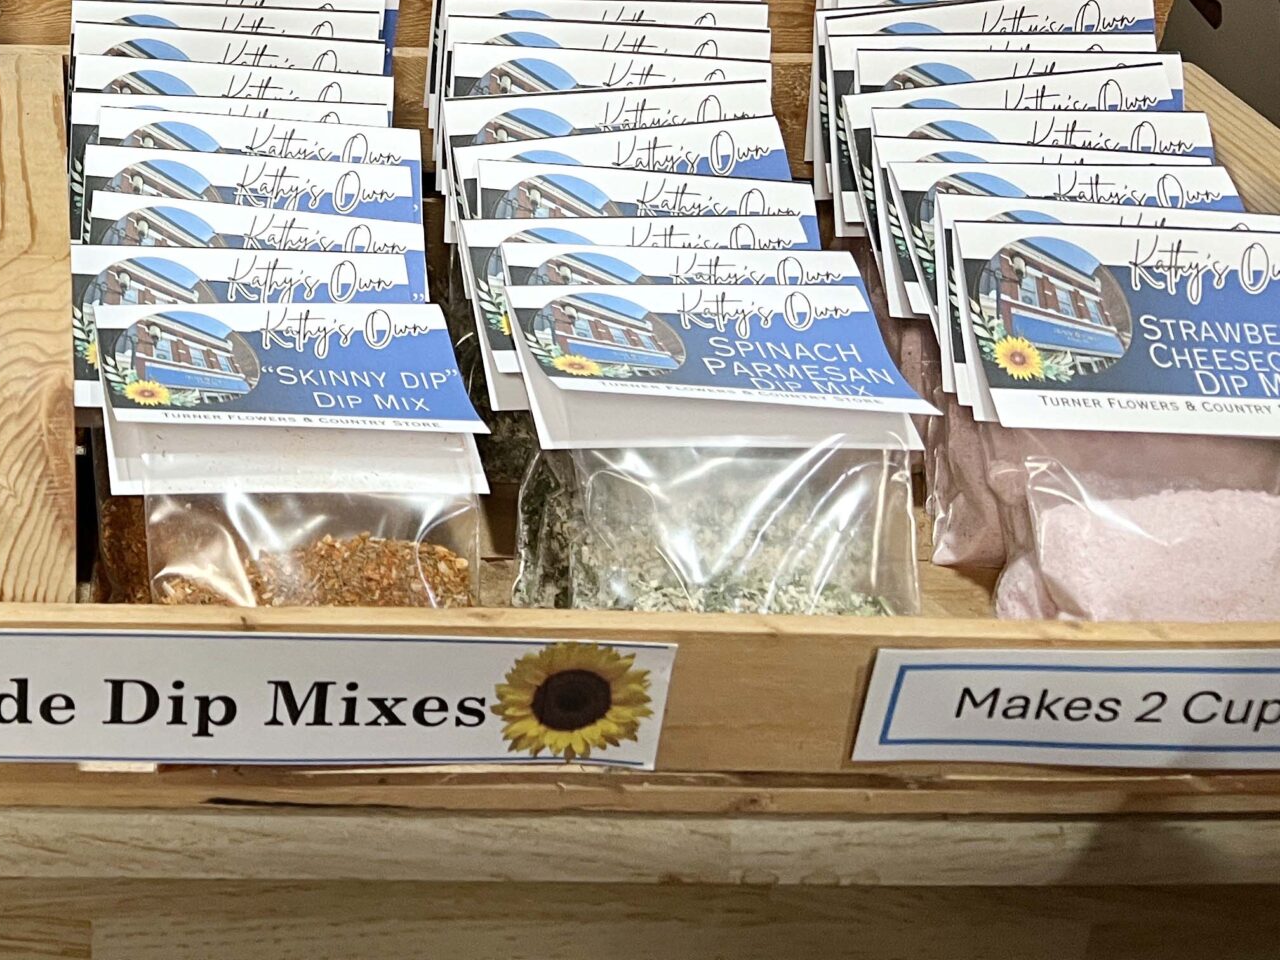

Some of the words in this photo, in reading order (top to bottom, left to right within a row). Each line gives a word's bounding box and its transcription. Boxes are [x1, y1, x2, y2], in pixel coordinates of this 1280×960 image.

[709, 129, 770, 176] Own
[234, 162, 326, 210] Kathy's
[332, 170, 396, 212] Own
[227, 256, 320, 302] Kathy's
[329, 260, 394, 303] Own
[1129, 235, 1229, 305] Kathy's
[676, 289, 773, 339] Kathy's
[784, 291, 851, 331] Own
[1139, 314, 1280, 345] STRAWBE
[260, 308, 353, 359] Kathy's
[365, 309, 430, 349] Own
[708, 336, 862, 363] SPINACH
[1148, 342, 1280, 372] CHEESEC
[702, 357, 896, 386] PARMESAN
[750, 377, 802, 392] DIP
[812, 381, 874, 397] MIX
[1195, 370, 1248, 396] DIP
[312, 392, 362, 409] DIP
[373, 394, 431, 412] MIX
[1039, 395, 1103, 408] TURNER
[1109, 398, 1180, 411] FLOWERS
[1186, 402, 1196, 412] &
[1201, 402, 1273, 414] COUNTRY
[162, 412, 222, 420] TURNER
[228, 414, 296, 423] FLOWERS
[318, 417, 388, 426] COUNTRY
[100, 677, 239, 740] Dip
[264, 680, 489, 730] Mixes
[954, 686, 1122, 723] Makes
[1134, 691, 1168, 724] 2
[1182, 690, 1280, 732] Cup
